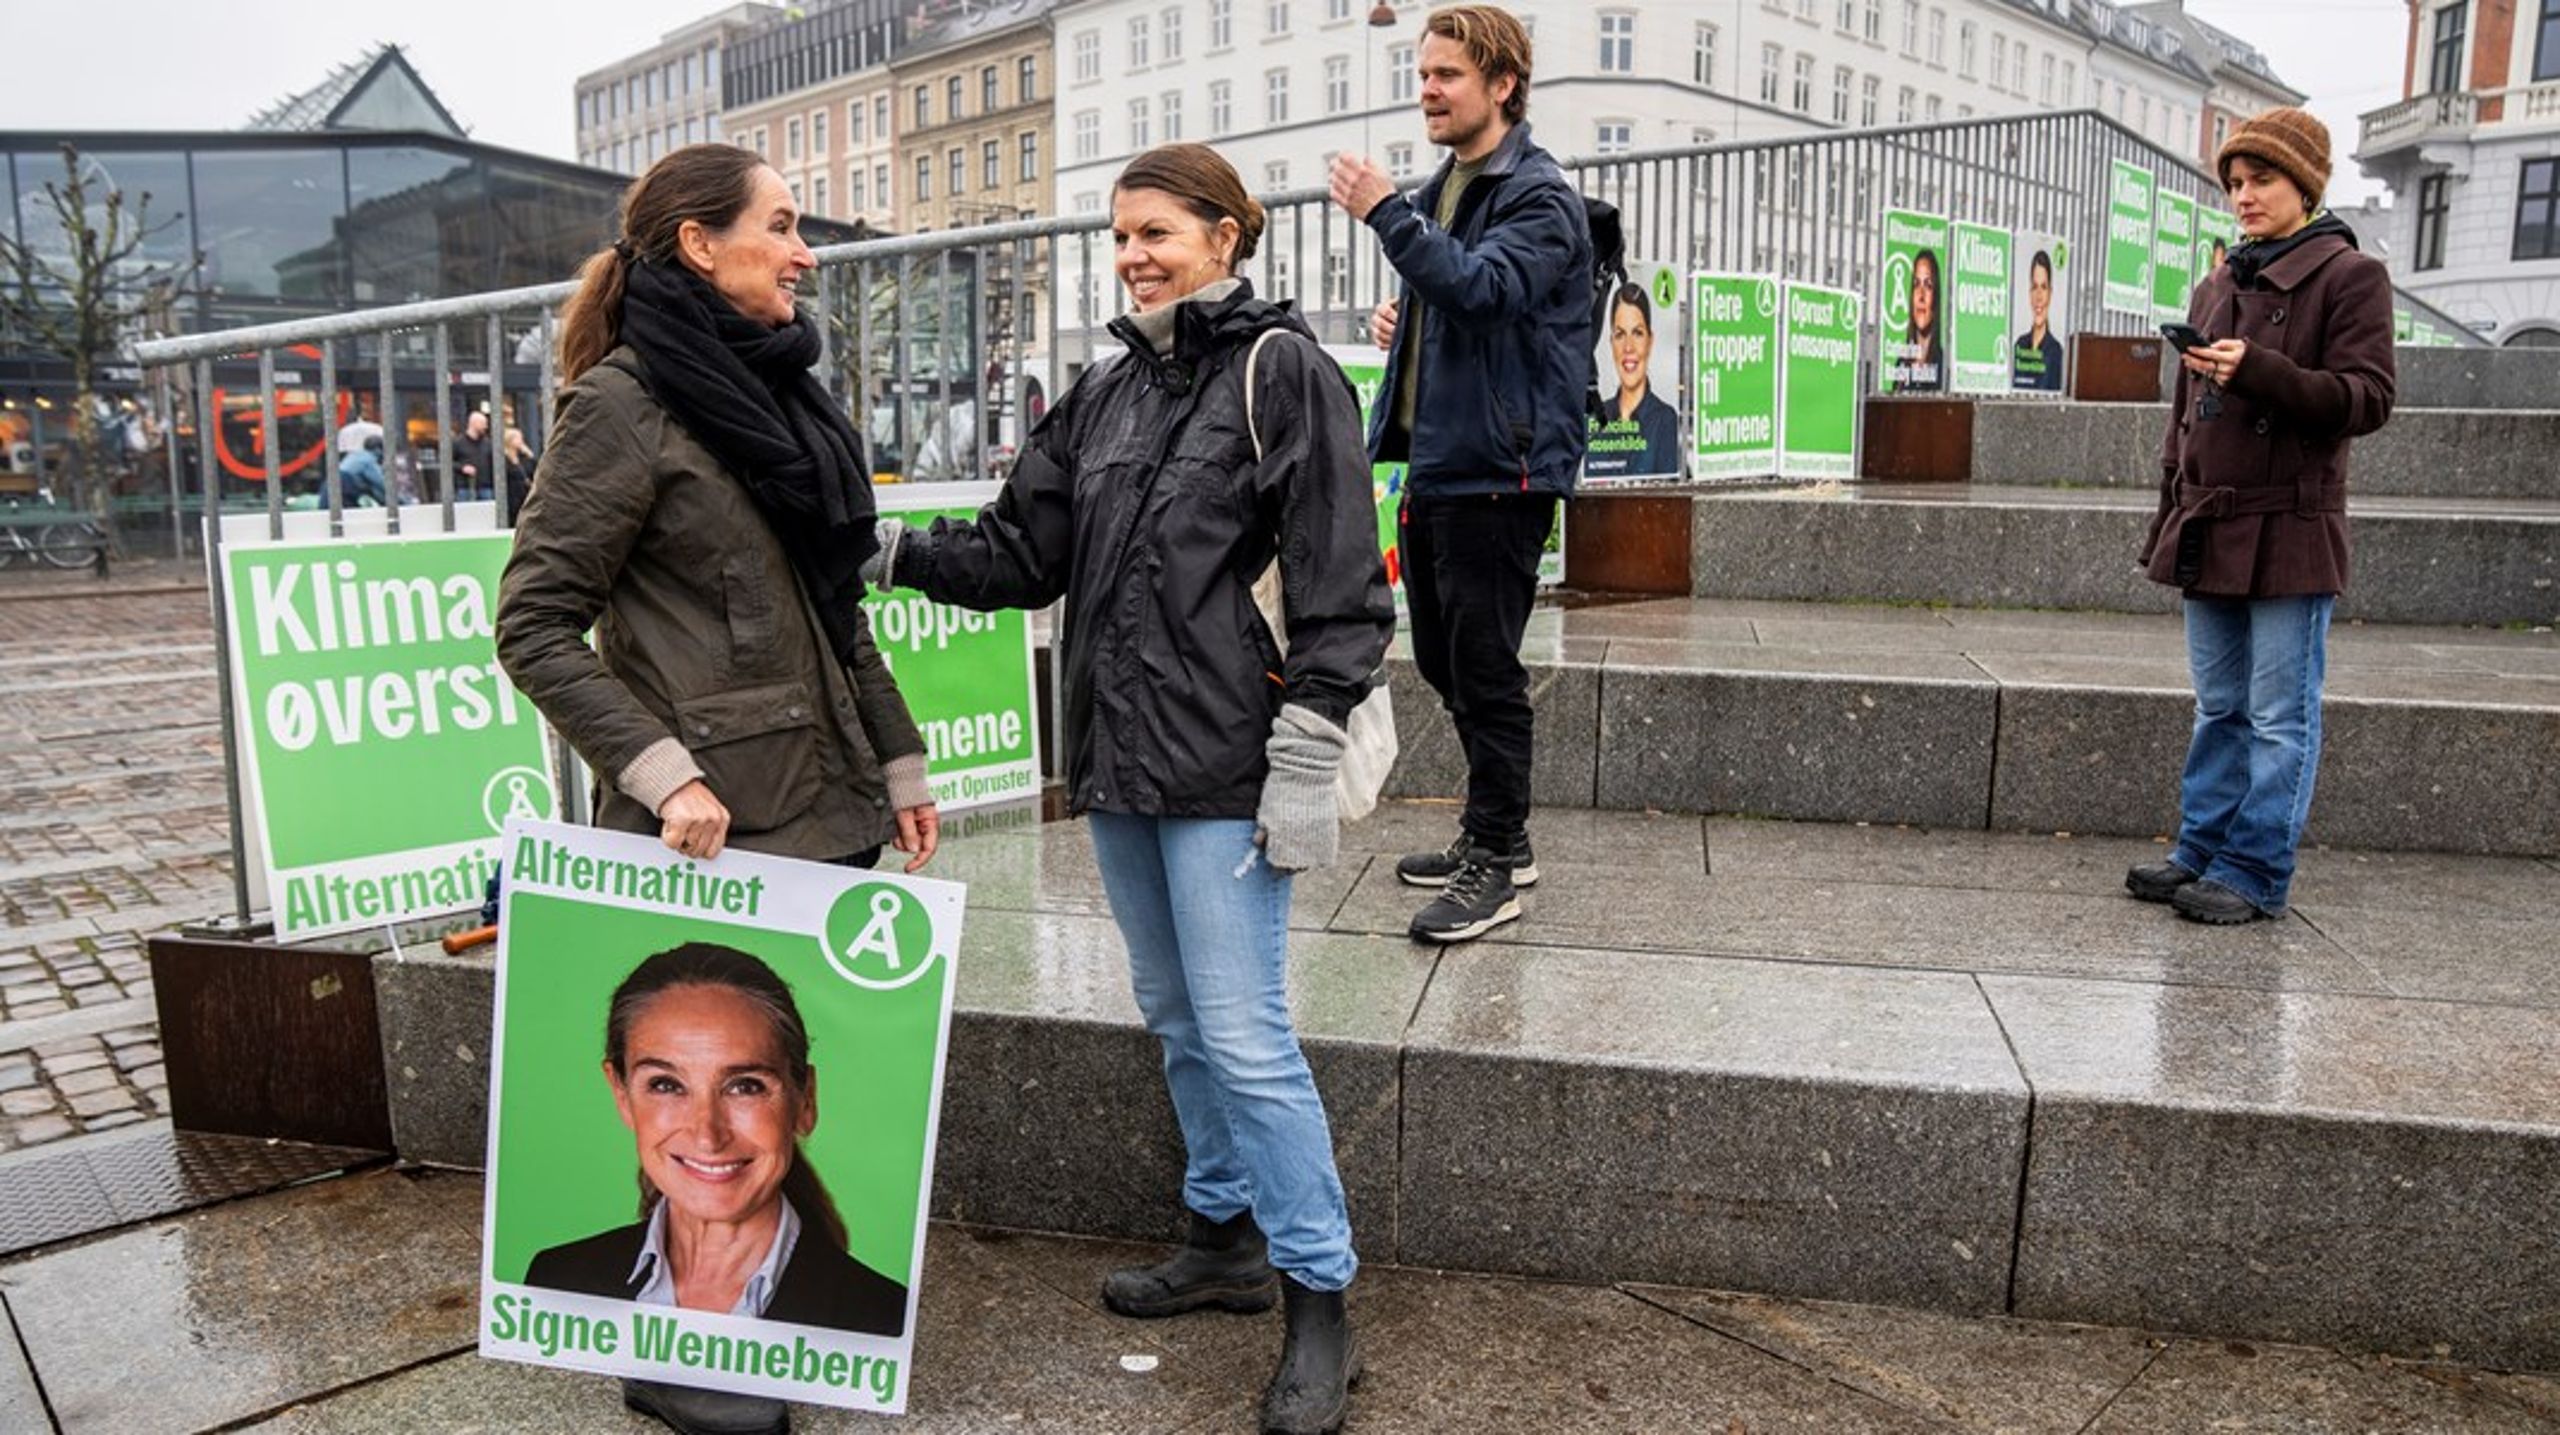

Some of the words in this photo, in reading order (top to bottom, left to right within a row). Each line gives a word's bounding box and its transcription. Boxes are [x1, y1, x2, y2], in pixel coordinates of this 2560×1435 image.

[1958, 231, 2004, 277] Klima
[1701, 284, 1743, 321] Flere
[1791, 292, 1834, 329] Oprust
[1701, 328, 1766, 371] tropper
[1791, 332, 1853, 367] omsorgen
[1701, 367, 1719, 405] til
[250, 559, 497, 656] Klima
[265, 653, 519, 751] øverst
[512, 836, 764, 917] Alternativet
[490, 1293, 619, 1358] Signe
[633, 1312, 899, 1404] Wenneberg
